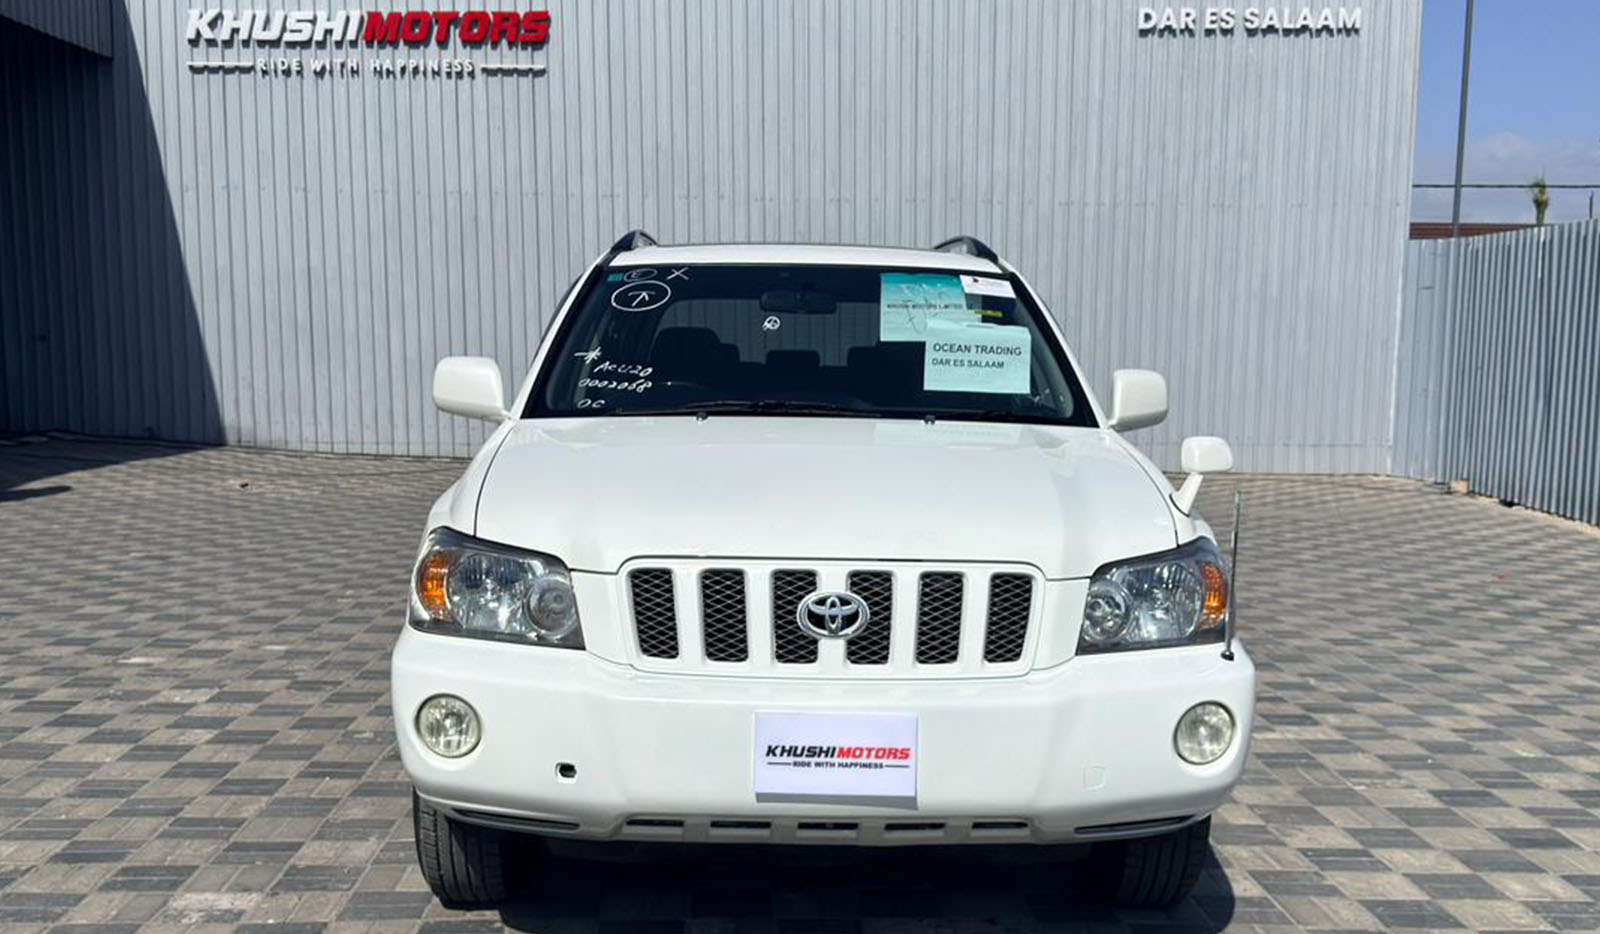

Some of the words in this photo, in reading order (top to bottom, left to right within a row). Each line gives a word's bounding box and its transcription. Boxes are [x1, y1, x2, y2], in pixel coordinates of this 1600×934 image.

[1138, 7, 1197, 29] DAR
[1204, 8, 1236, 29] ES
[1243, 7, 1362, 29] SALAAM
[257, 58, 301, 71] RIDE
[310, 59, 359, 71] WITH
[370, 59, 474, 72] HAPPINESS
[933, 343, 972, 354] OCEAN
[974, 344, 1022, 357] TRADING
[931, 358, 951, 367] DAR
[953, 359, 965, 368] ES
[967, 360, 1005, 370] SALAAM
[793, 761, 812, 769] RIDE
[814, 761, 836, 769] WITH
[837, 762, 884, 770] HAPPINESS
